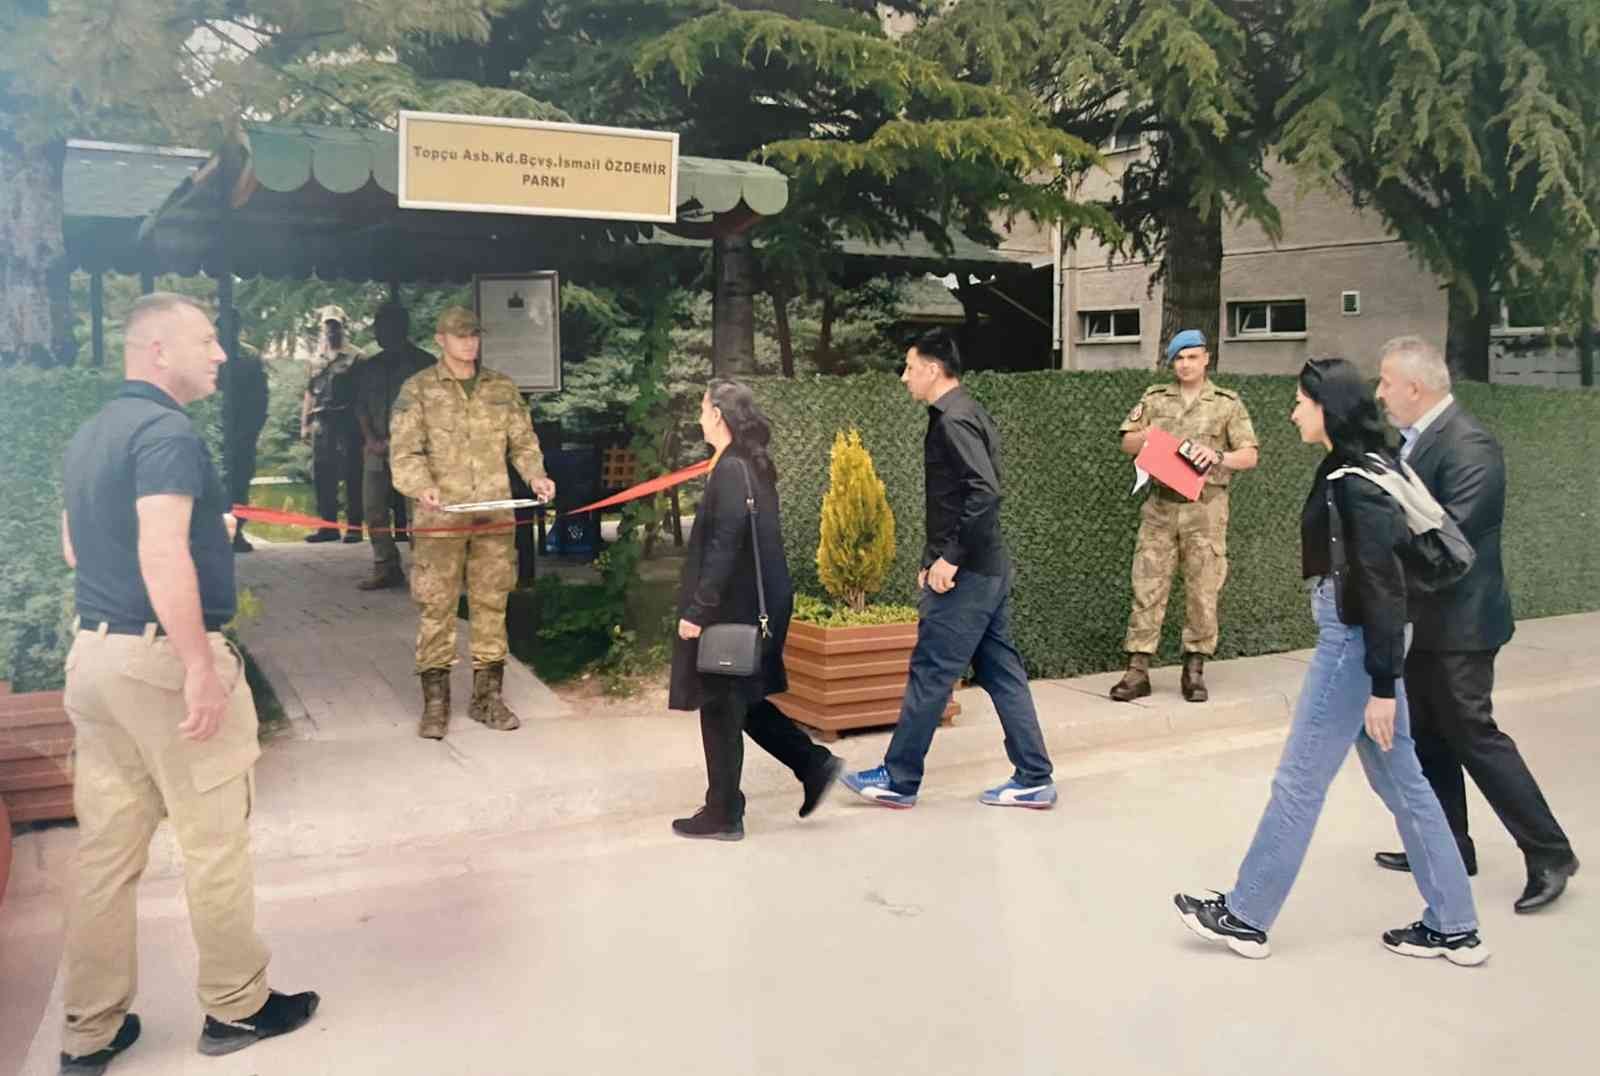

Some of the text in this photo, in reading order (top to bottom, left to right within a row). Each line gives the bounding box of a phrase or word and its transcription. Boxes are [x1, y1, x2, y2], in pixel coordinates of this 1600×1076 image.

[413, 145, 458, 161] Topçu
[604, 158, 667, 175] ÖZDEMİR
[522, 174, 565, 188] PARKI
